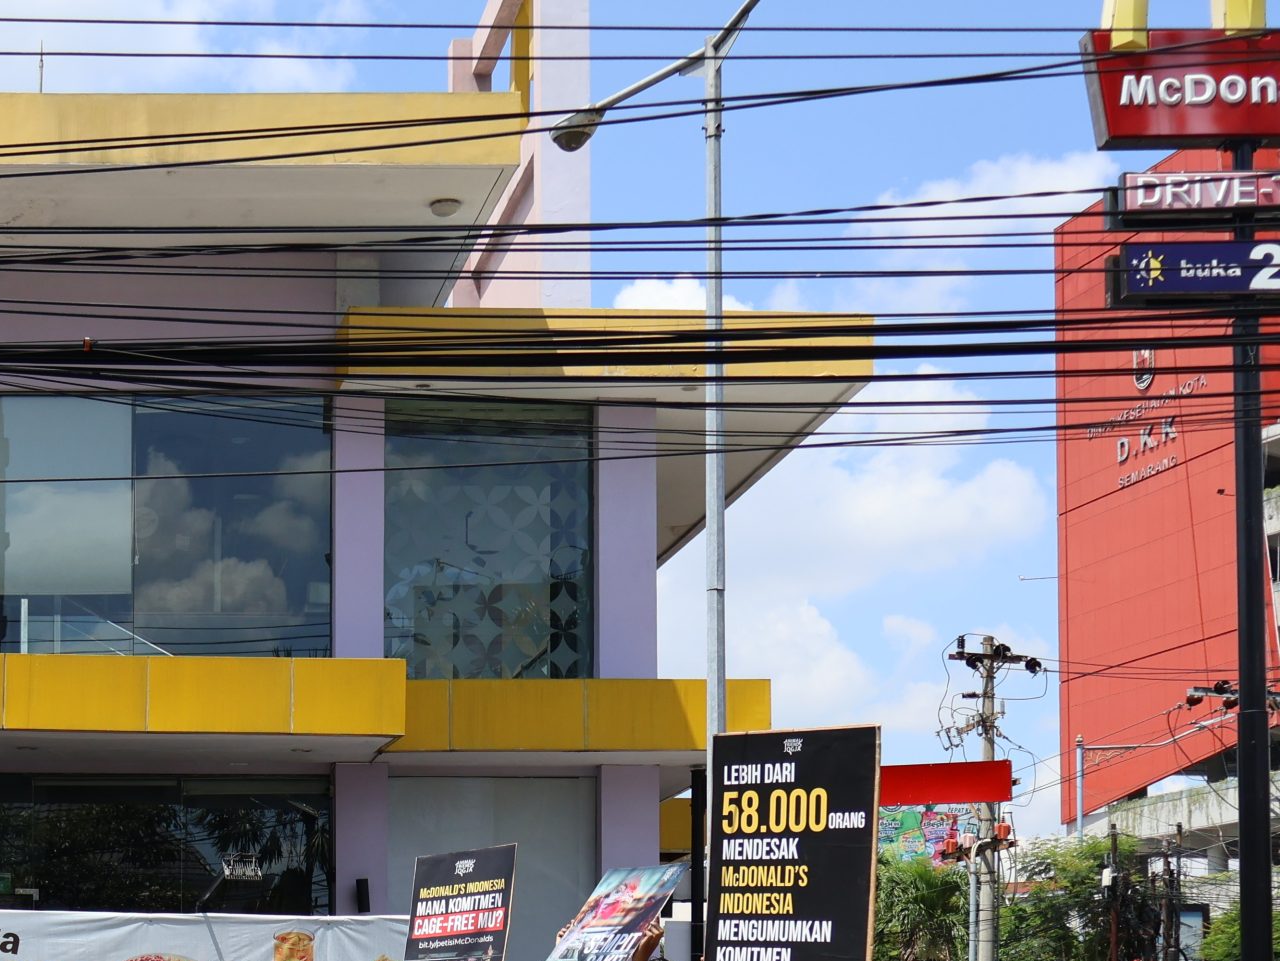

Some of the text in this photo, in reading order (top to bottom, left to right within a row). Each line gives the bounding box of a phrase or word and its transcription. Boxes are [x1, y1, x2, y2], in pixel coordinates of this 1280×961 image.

[1120, 74, 1280, 106] McDon
[1180, 259, 1242, 278] buka
[1179, 375, 1208, 396] KOTA
[1119, 456, 1178, 487] SEMARANG
[723, 762, 796, 786] LEBIH DARI
[721, 787, 866, 835] 58.000 ORANG
[722, 837, 799, 861] MENDESAK
[466, 878, 505, 894] INDONESIA
[721, 865, 808, 888] McDONALD'S
[416, 892, 503, 917] MANA KOMITMEN
[719, 892, 794, 915] INDONESIA
[414, 911, 504, 936] CAGE-FREE MU?
[717, 919, 832, 943] MENGUMUMKAN
[583, 931, 643, 954] SEMPIT
